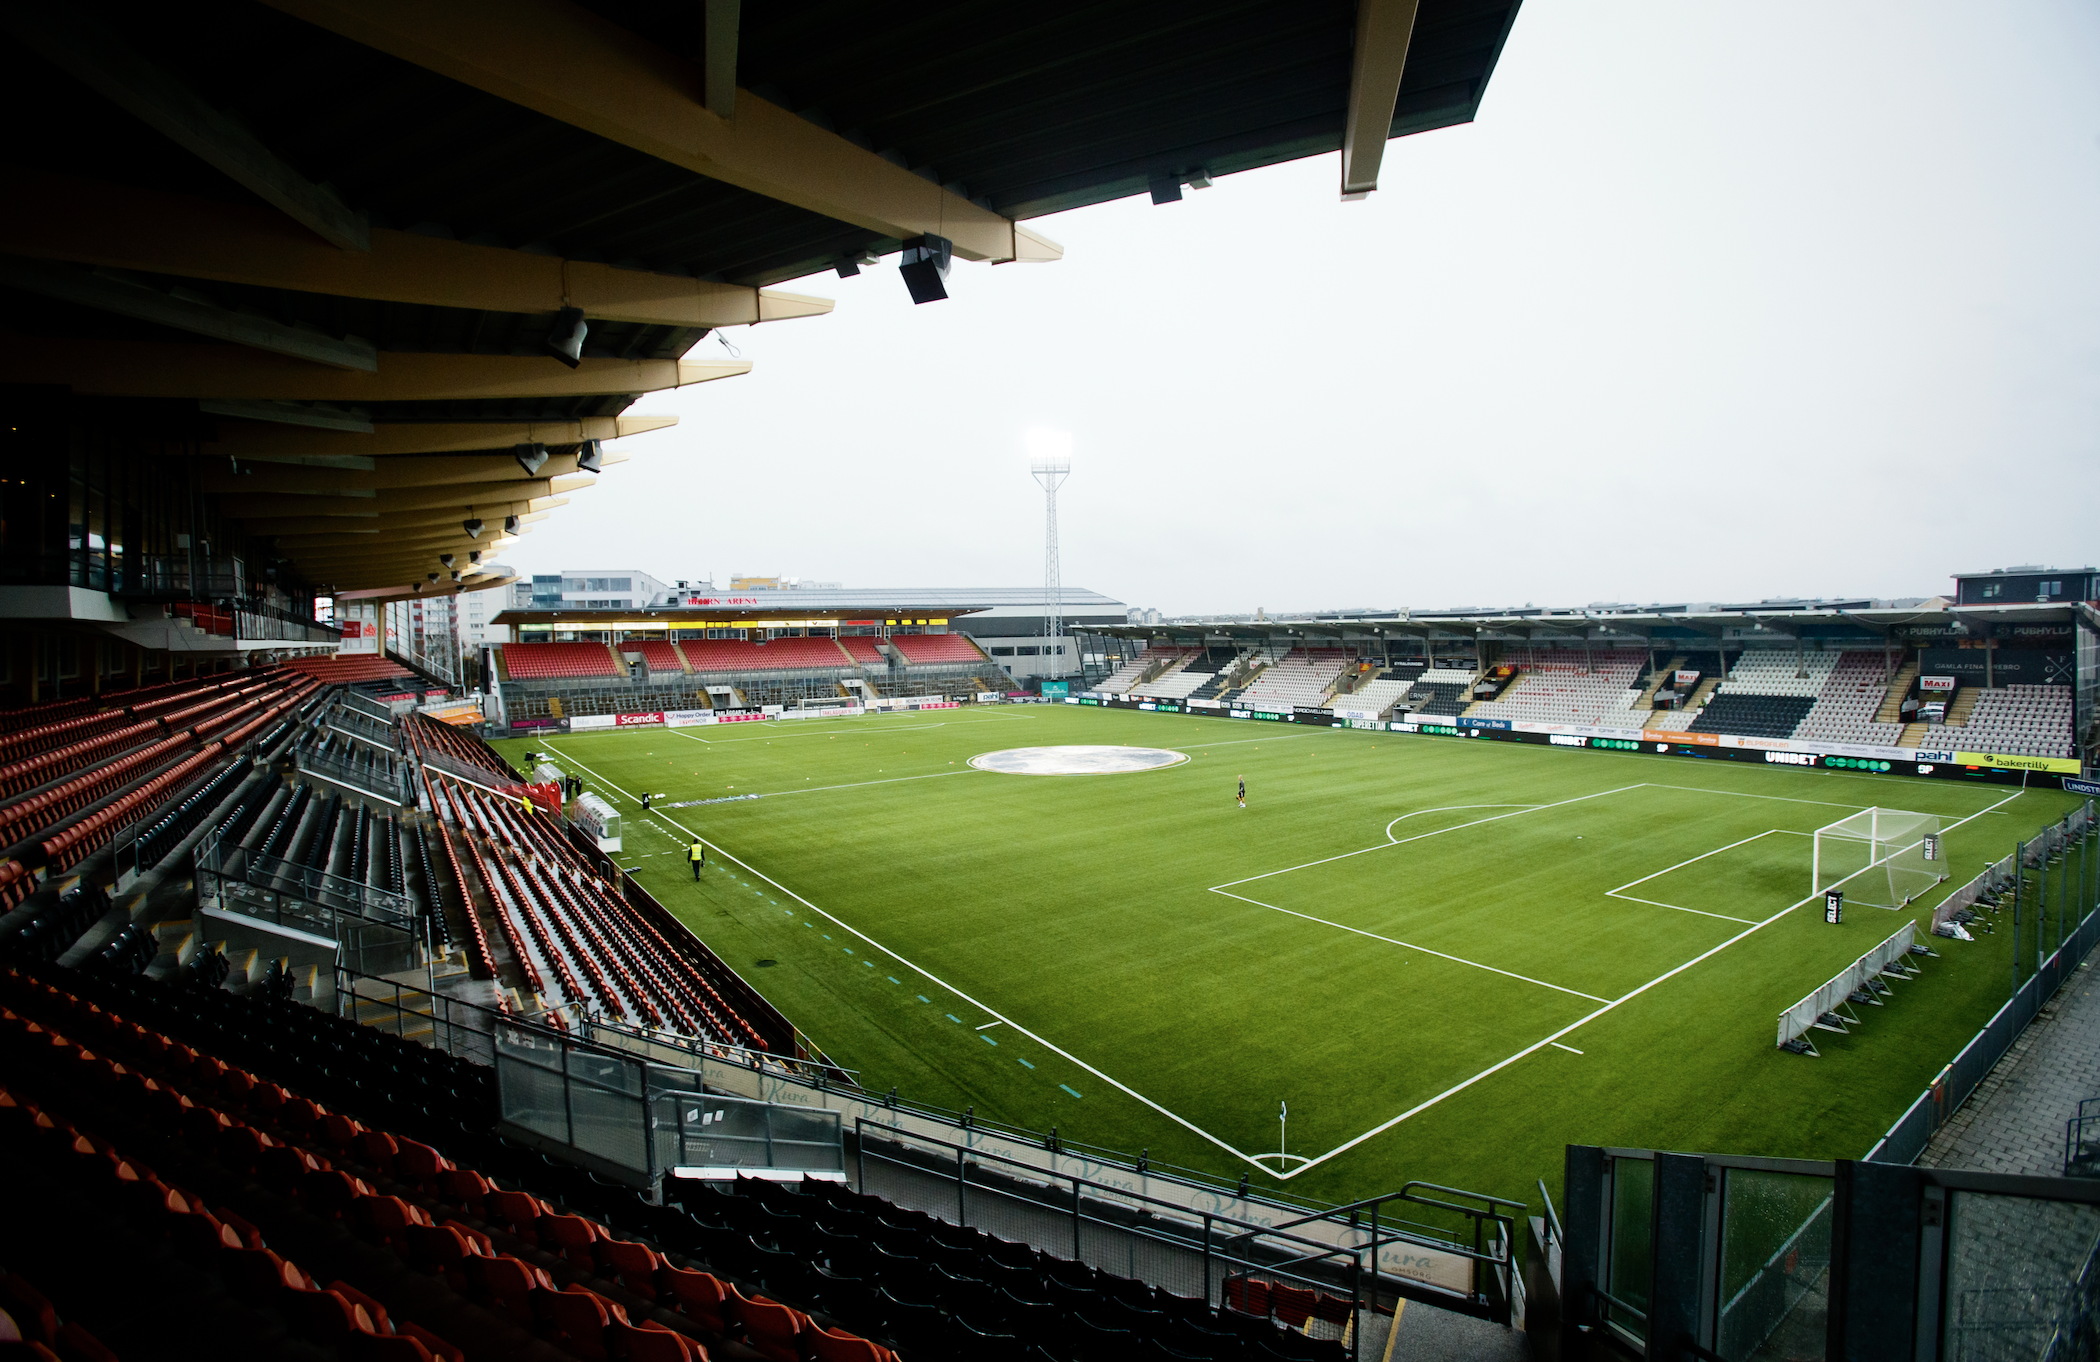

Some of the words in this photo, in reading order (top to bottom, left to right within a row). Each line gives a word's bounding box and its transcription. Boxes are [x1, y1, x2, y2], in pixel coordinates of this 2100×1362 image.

[726, 597, 758, 605] ARENA
[621, 713, 660, 724] Scandic
[1351, 719, 1386, 731] SUPERETTAN
[1390, 722, 1419, 733] UNIBET
[1549, 734, 1588, 747] UNIBET
[1765, 751, 1818, 766] UNIBET
[1916, 751, 1952, 762] pahl
[1996, 758, 2049, 771] bakertilly
[1924, 837, 1934, 860] SELECT
[1827, 895, 1838, 923] SELECT
[757, 1075, 810, 1103] Kura
[948, 1126, 1016, 1162] Kura
[1060, 1157, 1134, 1195] Kura
[1103, 1190, 1135, 1204] OMSORG
[1190, 1189, 1273, 1231] Kura
[1337, 1228, 1434, 1270] Kura
[1391, 1266, 1432, 1280] OMSORG
